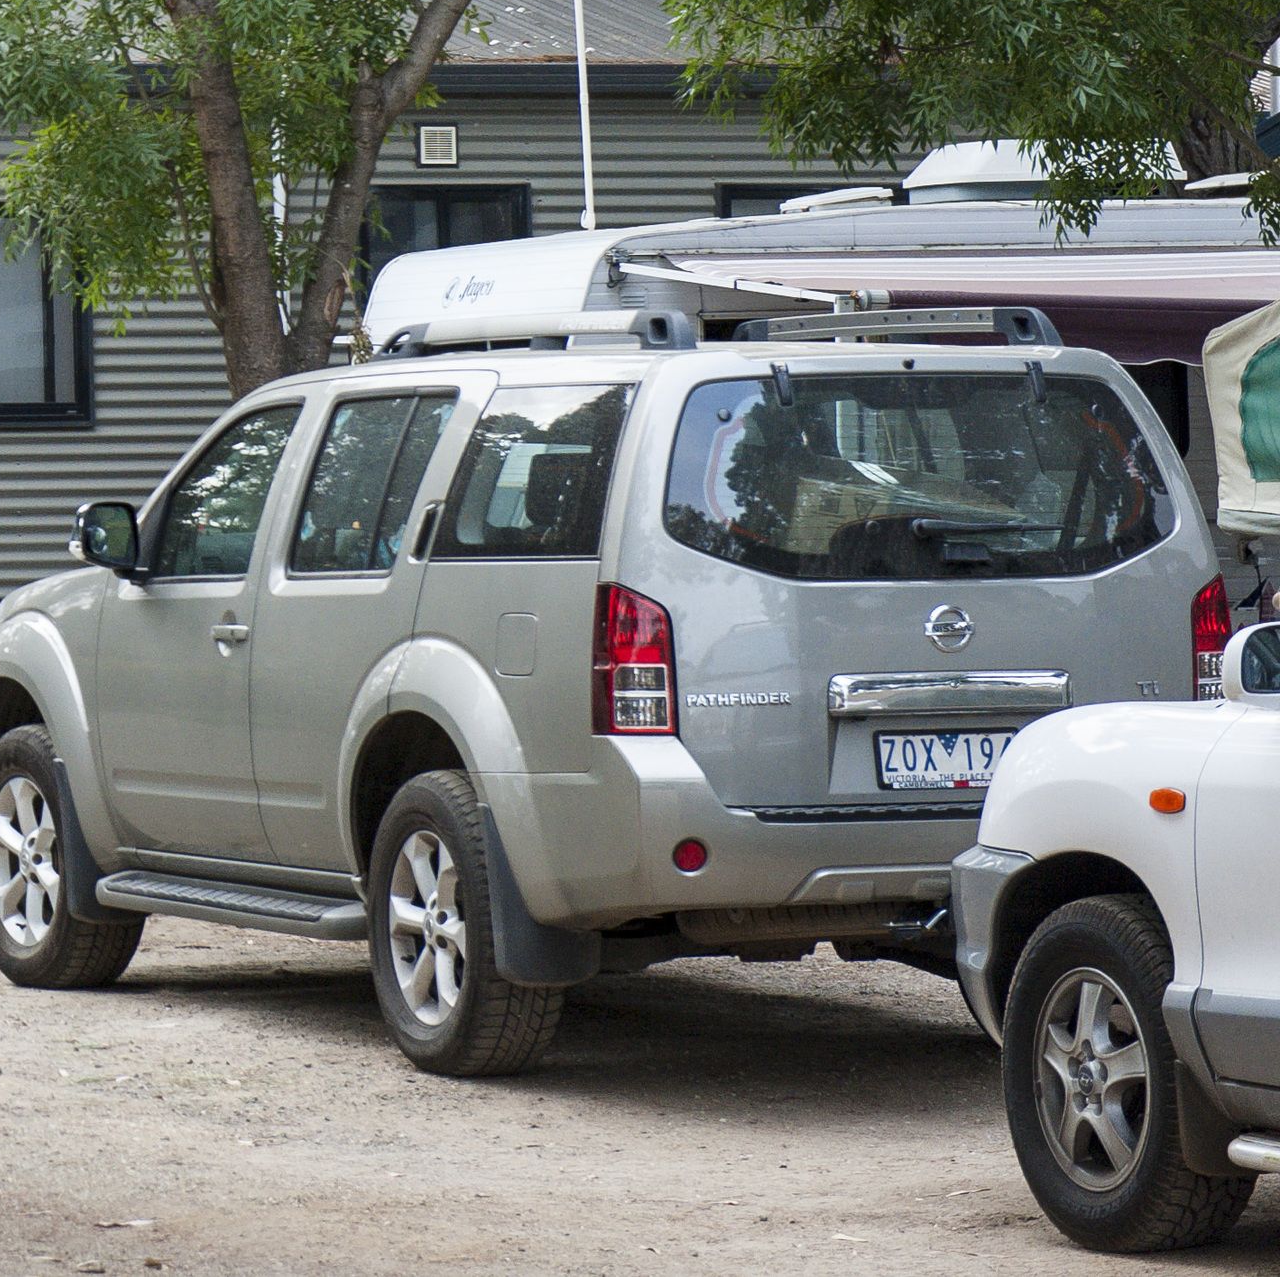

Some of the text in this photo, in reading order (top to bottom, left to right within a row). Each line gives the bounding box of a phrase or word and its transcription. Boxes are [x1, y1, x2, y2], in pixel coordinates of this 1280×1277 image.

[686, 690, 791, 707] PATHFINDER
[881, 738, 937, 772] ZOX
[886, 774, 926, 783] VICTORIA
[939, 773, 955, 782] THE
[959, 772, 985, 781] PLACE
[898, 781, 950, 789] CAMBERWELL
